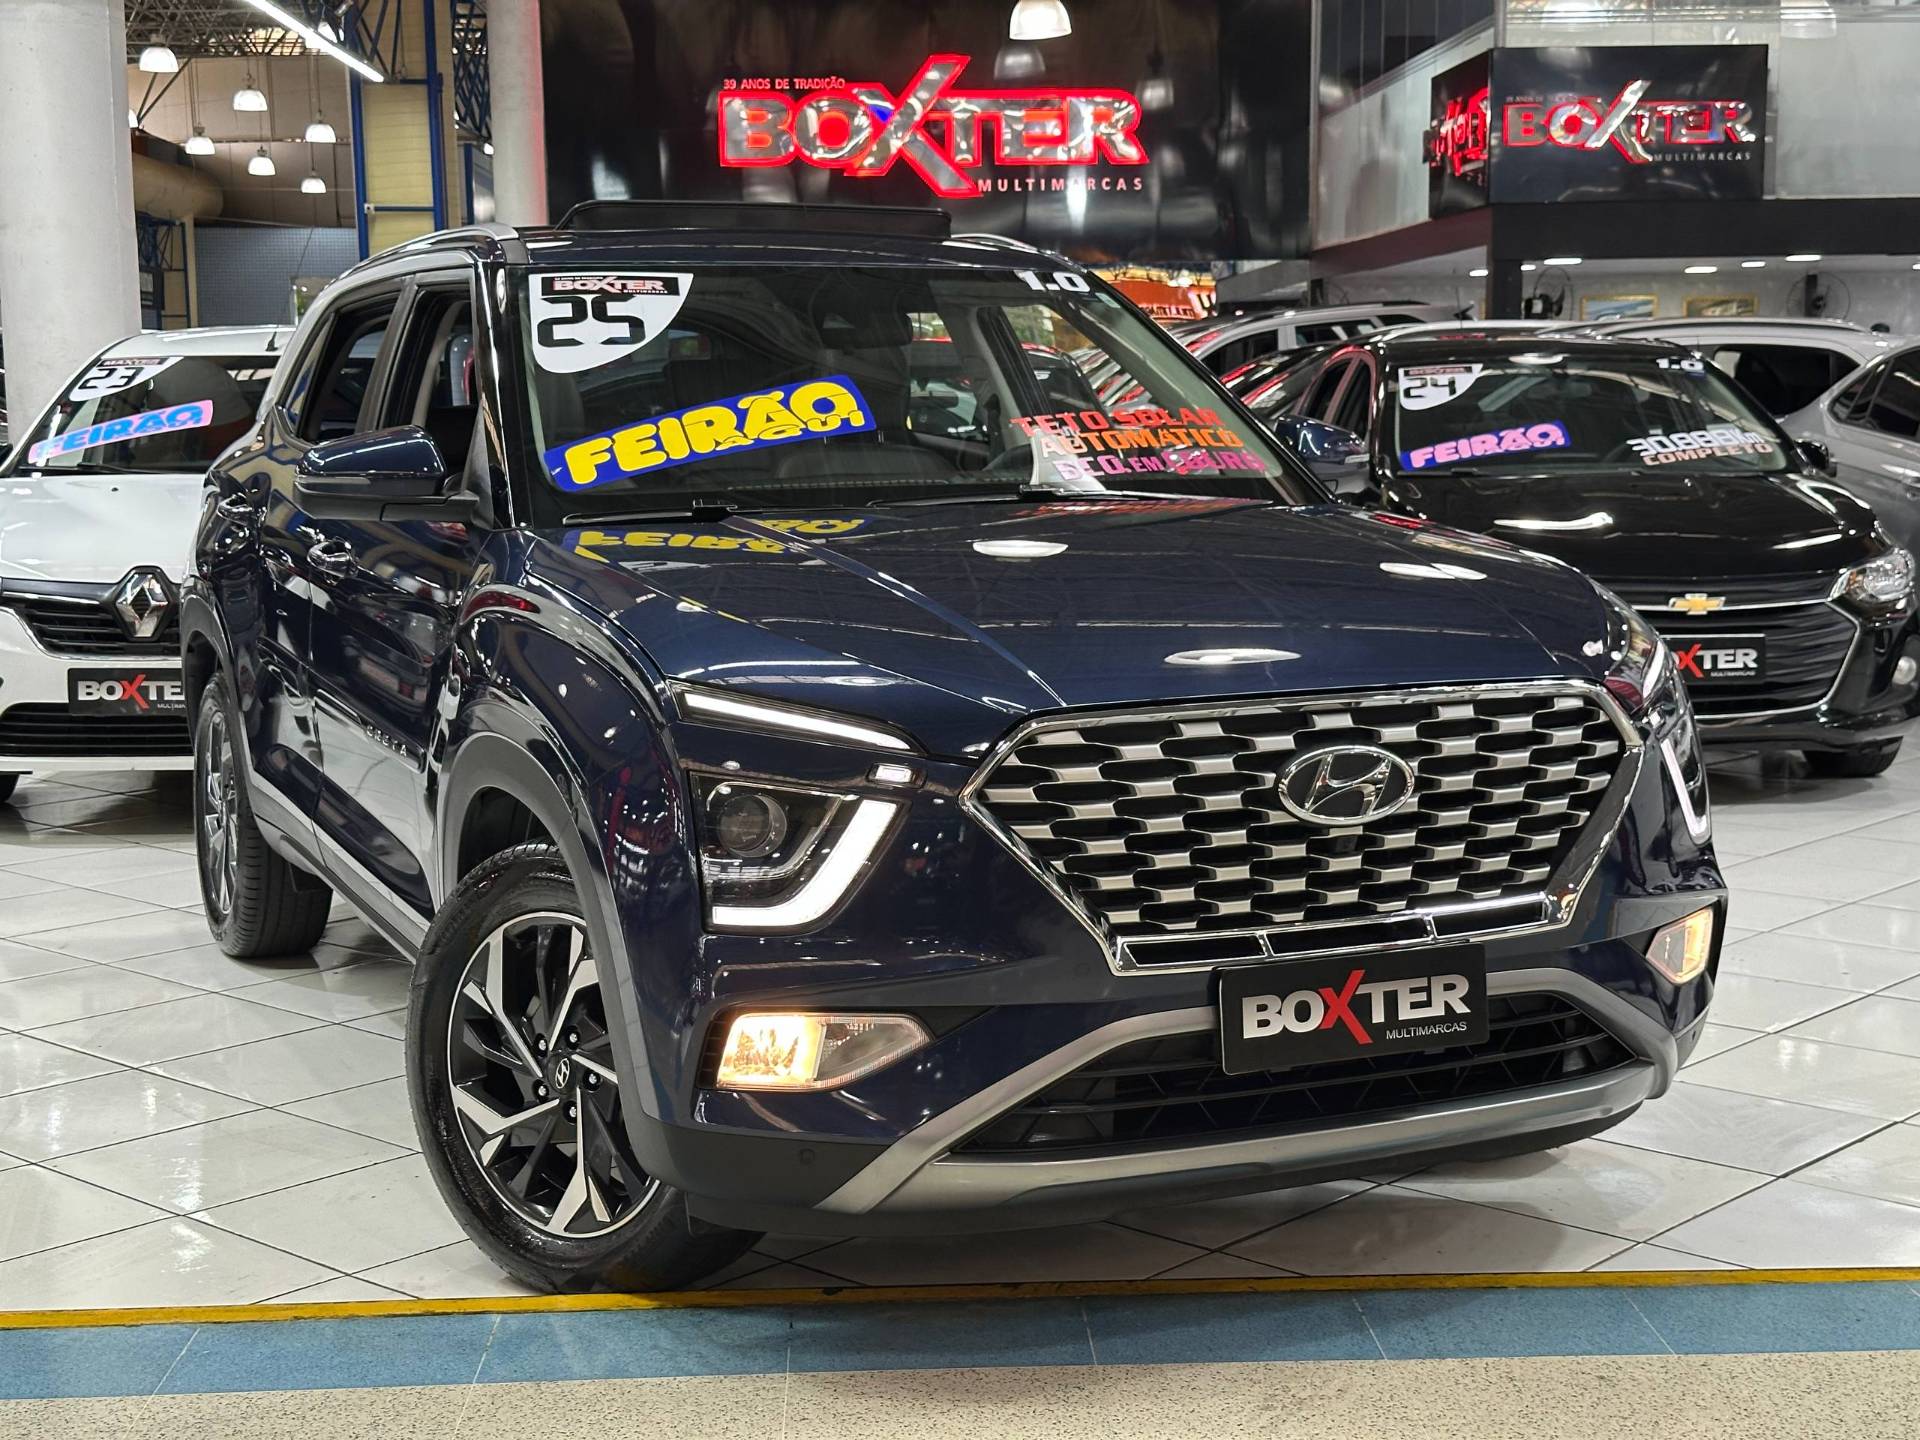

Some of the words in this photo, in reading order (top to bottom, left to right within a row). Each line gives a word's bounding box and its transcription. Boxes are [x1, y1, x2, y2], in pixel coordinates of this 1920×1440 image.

[723, 79, 737, 90] 39
[740, 79, 771, 90] ANOS
[774, 79, 790, 90] DE
[793, 75, 846, 91] TRADIÇÃO
[719, 54, 1150, 198] BOXTER
[1503, 80, 1757, 164] BOXTER
[1654, 151, 1751, 162] MULTIMARCAS
[977, 177, 1144, 193] MULTIMARCAS
[553, 276, 666, 294] BOXTER
[1014, 270, 1091, 293] 1.0
[537, 295, 647, 348] 25
[78, 366, 144, 390] 23
[1404, 376, 1457, 398] 24
[36, 404, 204, 461] FEIRÃO
[564, 381, 858, 484] FEIRÃO
[1009, 411, 1109, 437] TETO
[1111, 407, 1226, 428] SOLAR
[1410, 423, 1565, 468] FEIRÃO
[1642, 442, 1773, 466] COMPLETO
[1671, 643, 1758, 678] XTER
[78, 674, 185, 709] BOXTE
[1243, 969, 1471, 1045] BOXTER
[1386, 1021, 1467, 1040] MULTIMARCAS
